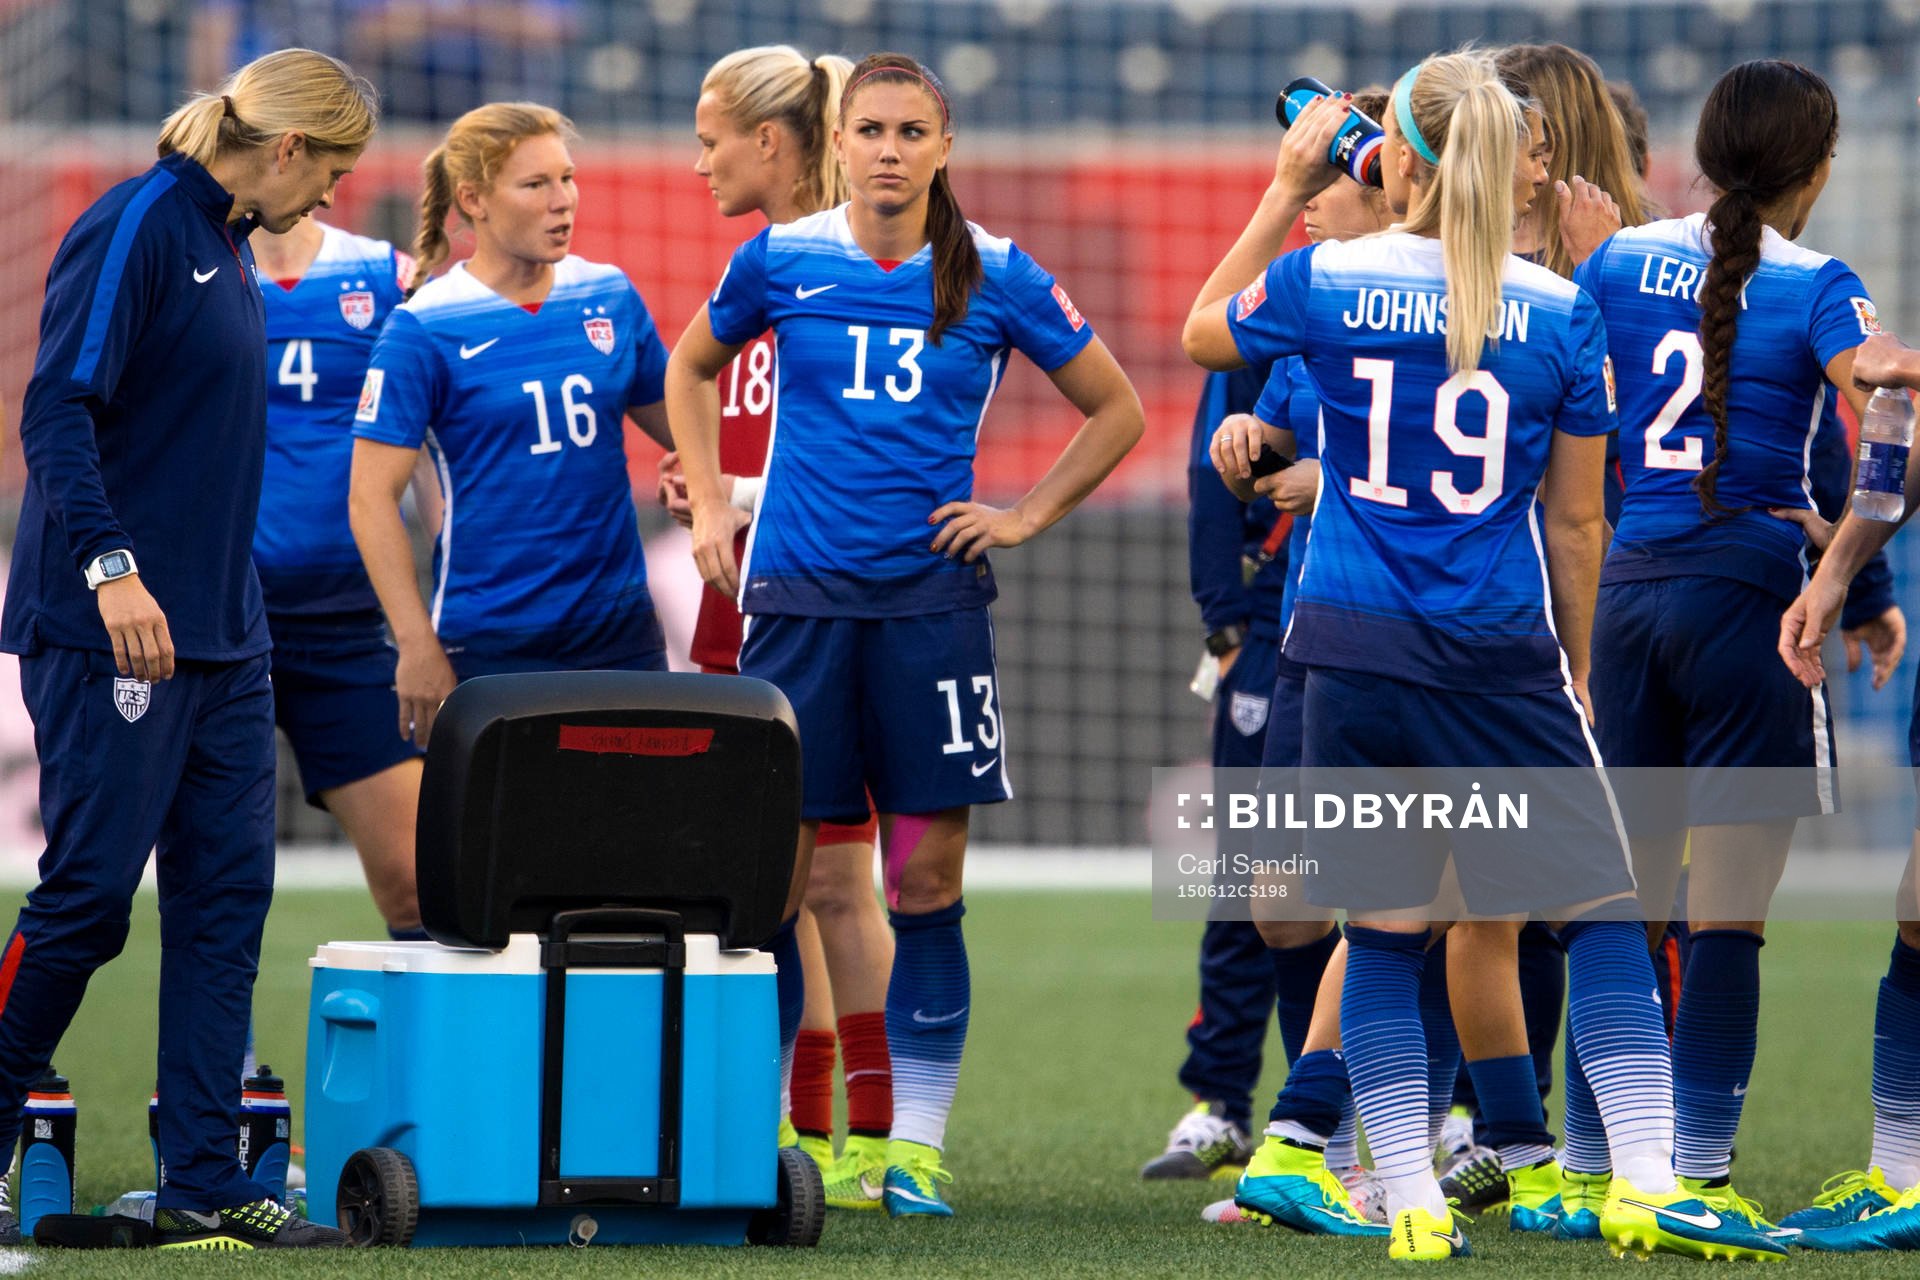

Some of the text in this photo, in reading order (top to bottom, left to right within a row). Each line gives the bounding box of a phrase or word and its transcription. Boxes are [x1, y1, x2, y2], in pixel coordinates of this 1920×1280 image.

[1343, 287, 1530, 343] JOHNON
[278, 339, 318, 402] 4
[722, 341, 772, 417] 18
[842, 325, 925, 402] 13
[1644, 329, 1704, 470] 2
[522, 374, 598, 455] 16
[1350, 357, 1510, 515] 19
[937, 675, 1000, 755] 13
